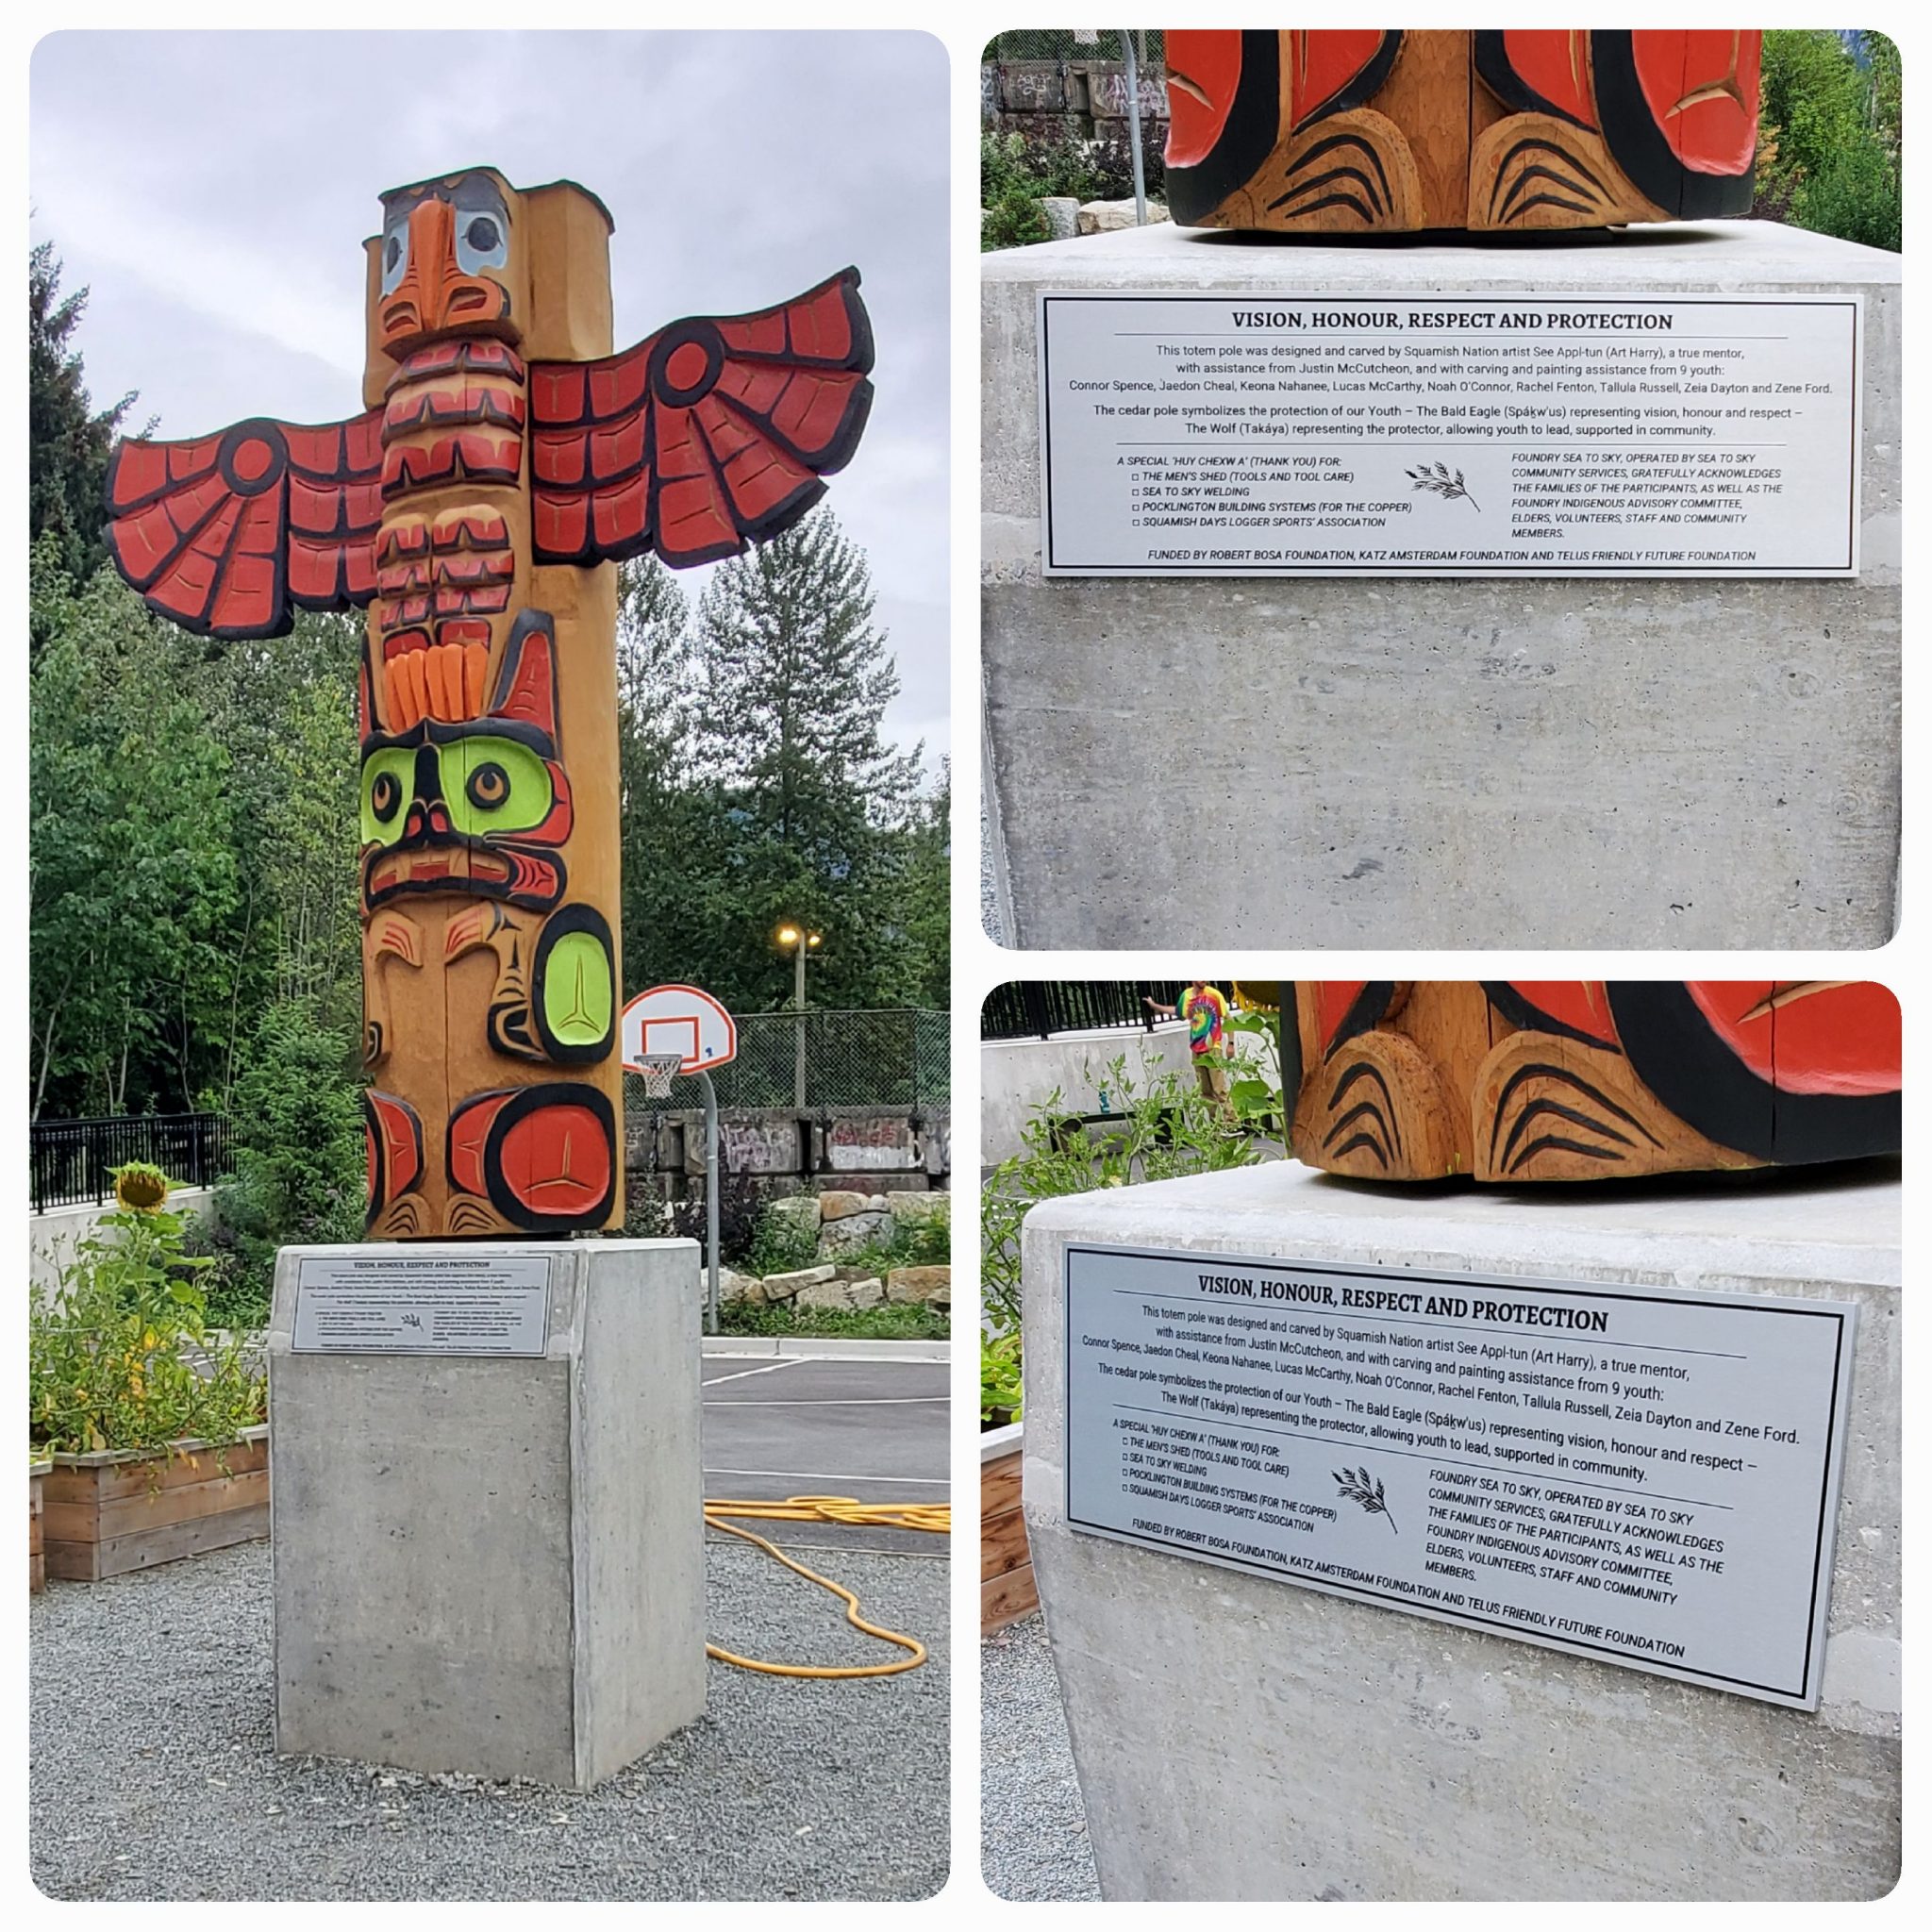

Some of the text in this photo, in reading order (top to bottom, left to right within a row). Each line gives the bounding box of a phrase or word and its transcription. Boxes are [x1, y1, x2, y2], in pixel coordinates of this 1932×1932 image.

[1231, 311, 1674, 330] VISION, HONOUR, RESPECT AND PROTECTION
[1156, 344, 1744, 360] This totem pole was designed and carved by Squamish Nation artist See Appl-tun (Art Harry), a true mentor,
[1069, 379, 1109, 391] Connor
[1112, 379, 1157, 392] Spence,
[1158, 380, 1200, 391] Jaedon
[1203, 379, 1238, 392] Cheal,
[1240, 380, 1275, 391] Keona
[1278, 380, 1330, 392] Nahanee,
[1332, 380, 1366, 391] Lucas
[1368, 380, 1424, 394] McCarthy,
[1427, 380, 1457, 391] Noah
[1516, 381, 1554, 392] Rachel
[1557, 381, 1597, 394] Fenton,
[1599, 381, 1636, 392] Tallula
[1639, 381, 1681, 394] Russell,
[1683, 382, 1707, 392] Zeia
[1710, 382, 1749, 395] Dayton
[1751, 382, 1772, 393] and
[1774, 383, 1802, 393] Zene
[1805, 383, 1832, 393] Ford.
[1116, 457, 1124, 465] A
[1126, 456, 1170, 466] SPECIAL
[1197, 456, 1237, 466] CHEXW
[1249, 456, 1290, 468] (THANK
[1291, 456, 1317, 468] YOU)
[1318, 457, 1341, 466] FOR:
[1141, 471, 1163, 481] THE
[1198, 471, 1227, 481] SHED
[1228, 471, 1268, 483] (TOOLS
[1268, 472, 1291, 481] AND
[1293, 472, 1321, 482] TOOL
[1323, 471, 1354, 484] CARE)
[1141, 486, 1250, 496] SEA TO SKY WELDING
[1141, 501, 1412, 514] POCKLINGTON BUILDING SYSTEMS (FOR THE COPPER)
[1141, 516, 1198, 527] SQUAMISH
[1199, 516, 1227, 526] DAYS
[1228, 517, 1271, 526] LOGGER
[1315, 517, 1387, 527] ASSOCIATION
[1147, 549, 1757, 561] FUNDED BY ROBERT BOSA FOUNDATION, KATZ AMSTERDAM FOUNDATION AND TELUS FRIENDLY FUTURE FOUNDATION
[1197, 1274, 1609, 1333] VISION, HONOUR, RESPECT AND PROTECTION
[1155, 1325, 1664, 1402] with assistance from Justin McCutcheon, and with carving and painting assistance from 9 youth:
[1160, 1390, 1648, 1483] The Wolf (Takáya) representing the protector, allowing youth to lead, supported in community.
[1428, 1469, 1694, 1526] FOUNDRY SEA TO SKY, OPERATED BY SEA TO SKY
[1428, 1487, 1724, 1553] COMMUNITY SERVICES, GRATEFULLY ACKNOWLEDGES
[1428, 1505, 1724, 1574] THE FAMILIES OF THE PARTICIPANTS, AS WELL AS THE
[1426, 1524, 1673, 1587] FOUNDRY INDIGENOUS ADVISORY COMMITTEE,
[1424, 1559, 1477, 1582] MEMBERS.
[1425, 1541, 1678, 1606] ELDERS, VOLUNTEERS, STAFF AND COMMUNITY
